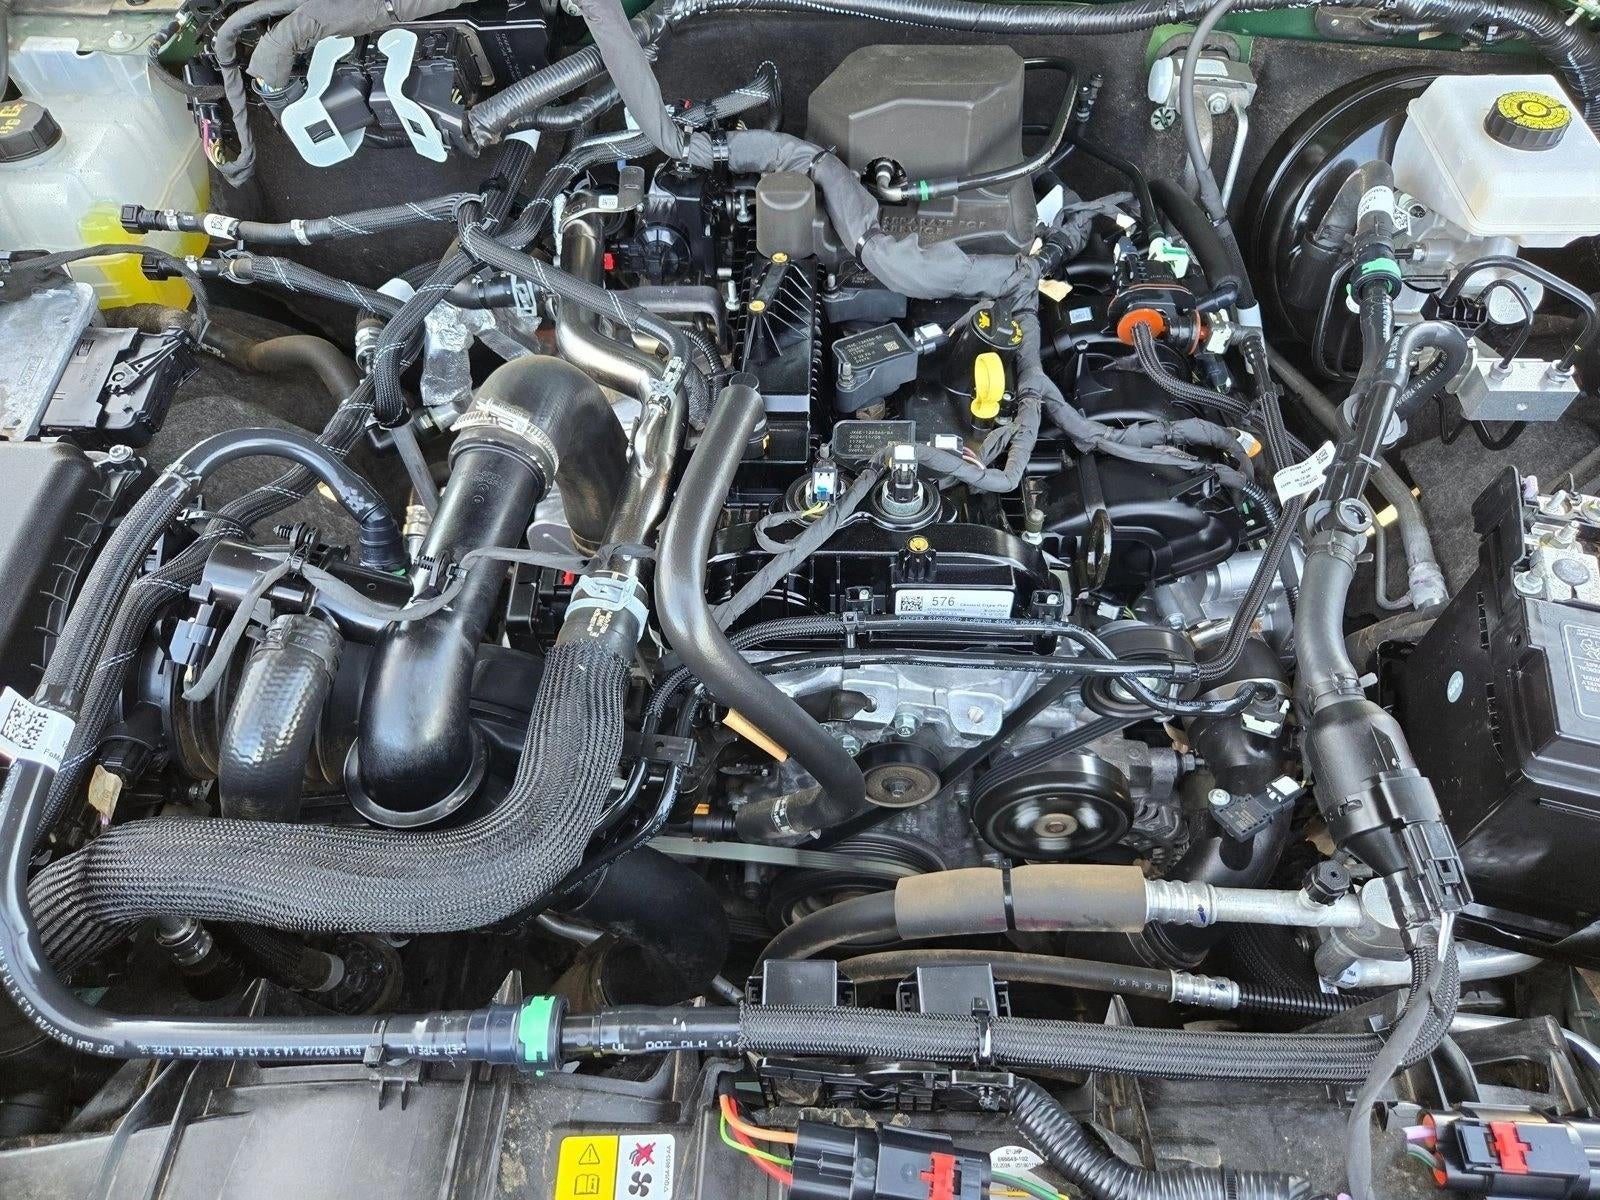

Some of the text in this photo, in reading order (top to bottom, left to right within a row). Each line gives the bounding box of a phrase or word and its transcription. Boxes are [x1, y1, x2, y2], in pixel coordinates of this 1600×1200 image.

[932, 596, 956, 607] 576
[645, 1040, 672, 1051] DOT
[680, 1040, 708, 1049] DLH
[263, 1046, 270, 1056] X
[298, 1046, 340, 1056] 09/27/24
